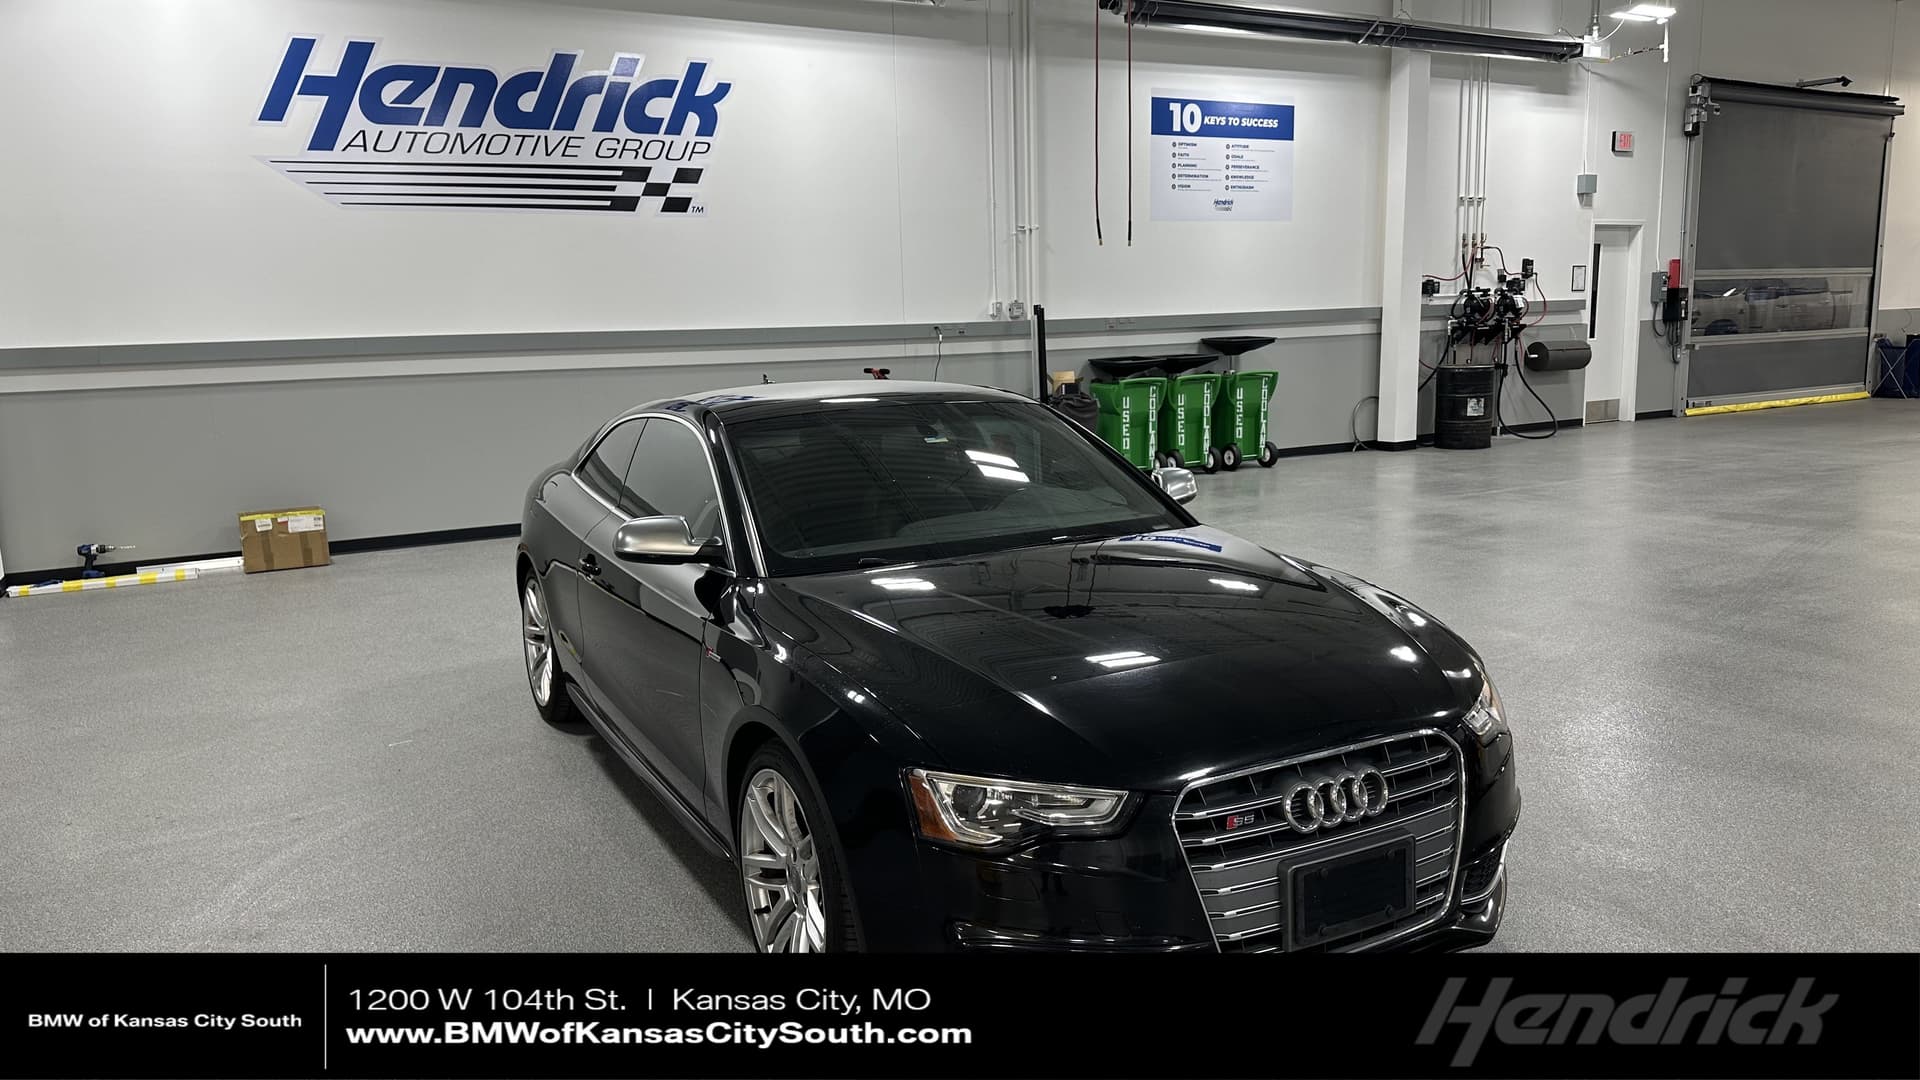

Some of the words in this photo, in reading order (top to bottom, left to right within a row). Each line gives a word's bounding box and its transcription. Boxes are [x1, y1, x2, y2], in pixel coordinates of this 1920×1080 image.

[258, 37, 732, 151] Hendrick
[1169, 102, 1202, 133] 10
[1203, 115, 1226, 126] KEYS
[1227, 116, 1240, 127] TO
[1240, 117, 1279, 129] SUCCESS
[341, 129, 585, 158] AUTOMOTIVE
[594, 136, 712, 162] GROUP
[1122, 396, 1131, 451] USED
[1148, 385, 1157, 469] COOLANT
[1177, 393, 1185, 446] USED
[1203, 381, 1211, 464] COOLANT
[1235, 387, 1243, 439] USED
[1259, 376, 1269, 457] COOLANT
